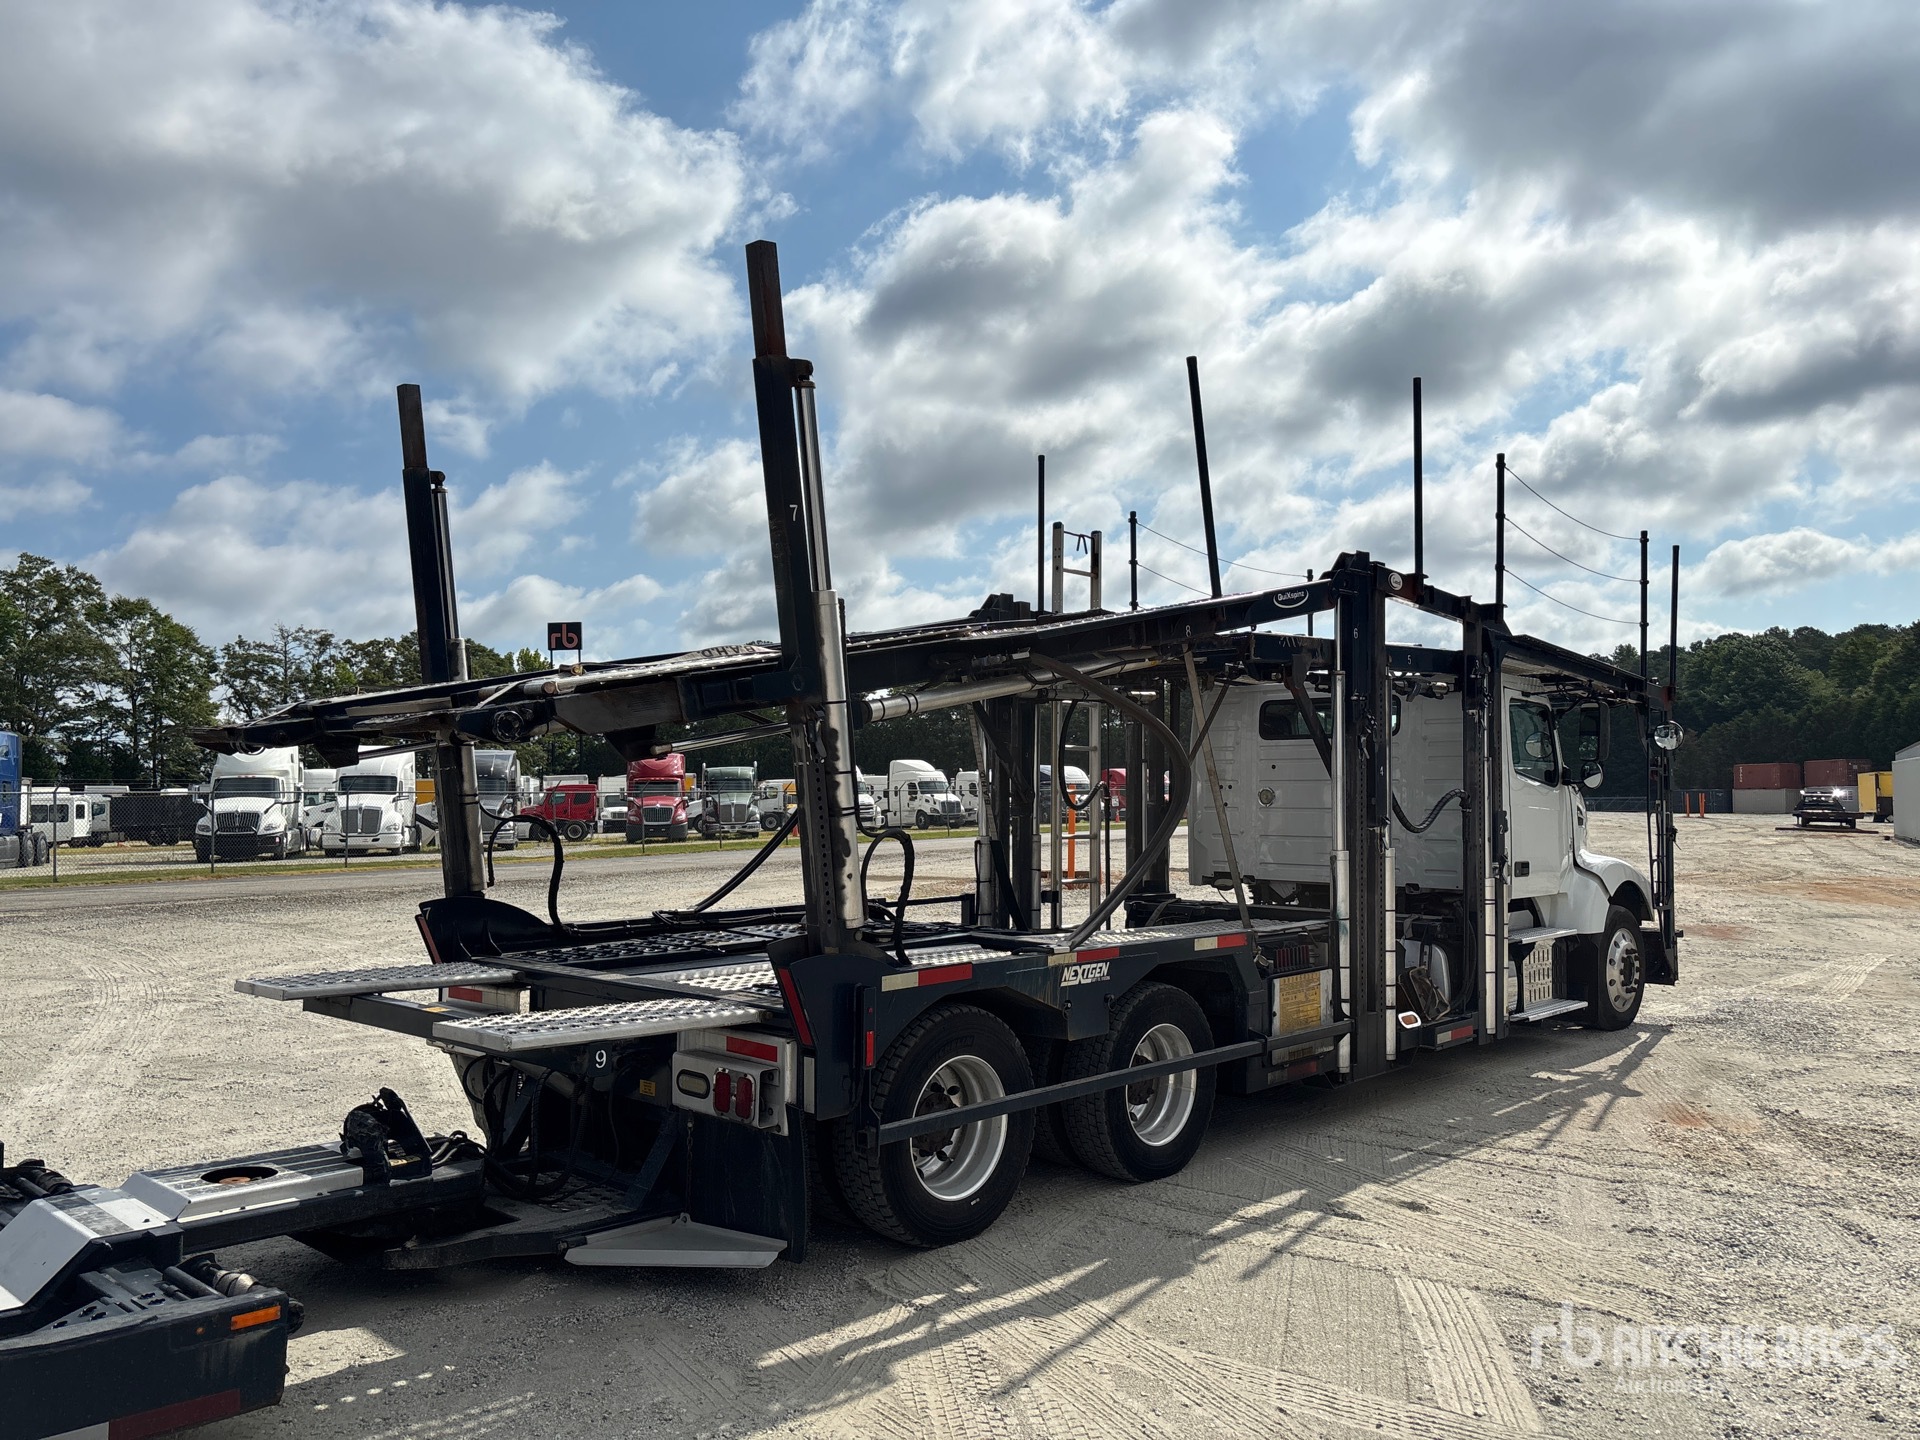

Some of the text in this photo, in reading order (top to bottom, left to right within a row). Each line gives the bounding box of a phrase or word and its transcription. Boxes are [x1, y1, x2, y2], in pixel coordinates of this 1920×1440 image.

[789, 504, 798, 522] 7
[550, 623, 579, 649] rb
[1185, 624, 1192, 638] 8
[1352, 627, 1359, 639] 6
[1407, 654, 1412, 665] 5
[422, 906, 432, 921] 7
[1061, 961, 1110, 987] NEXTGEN
[595, 1049, 607, 1069] 9
